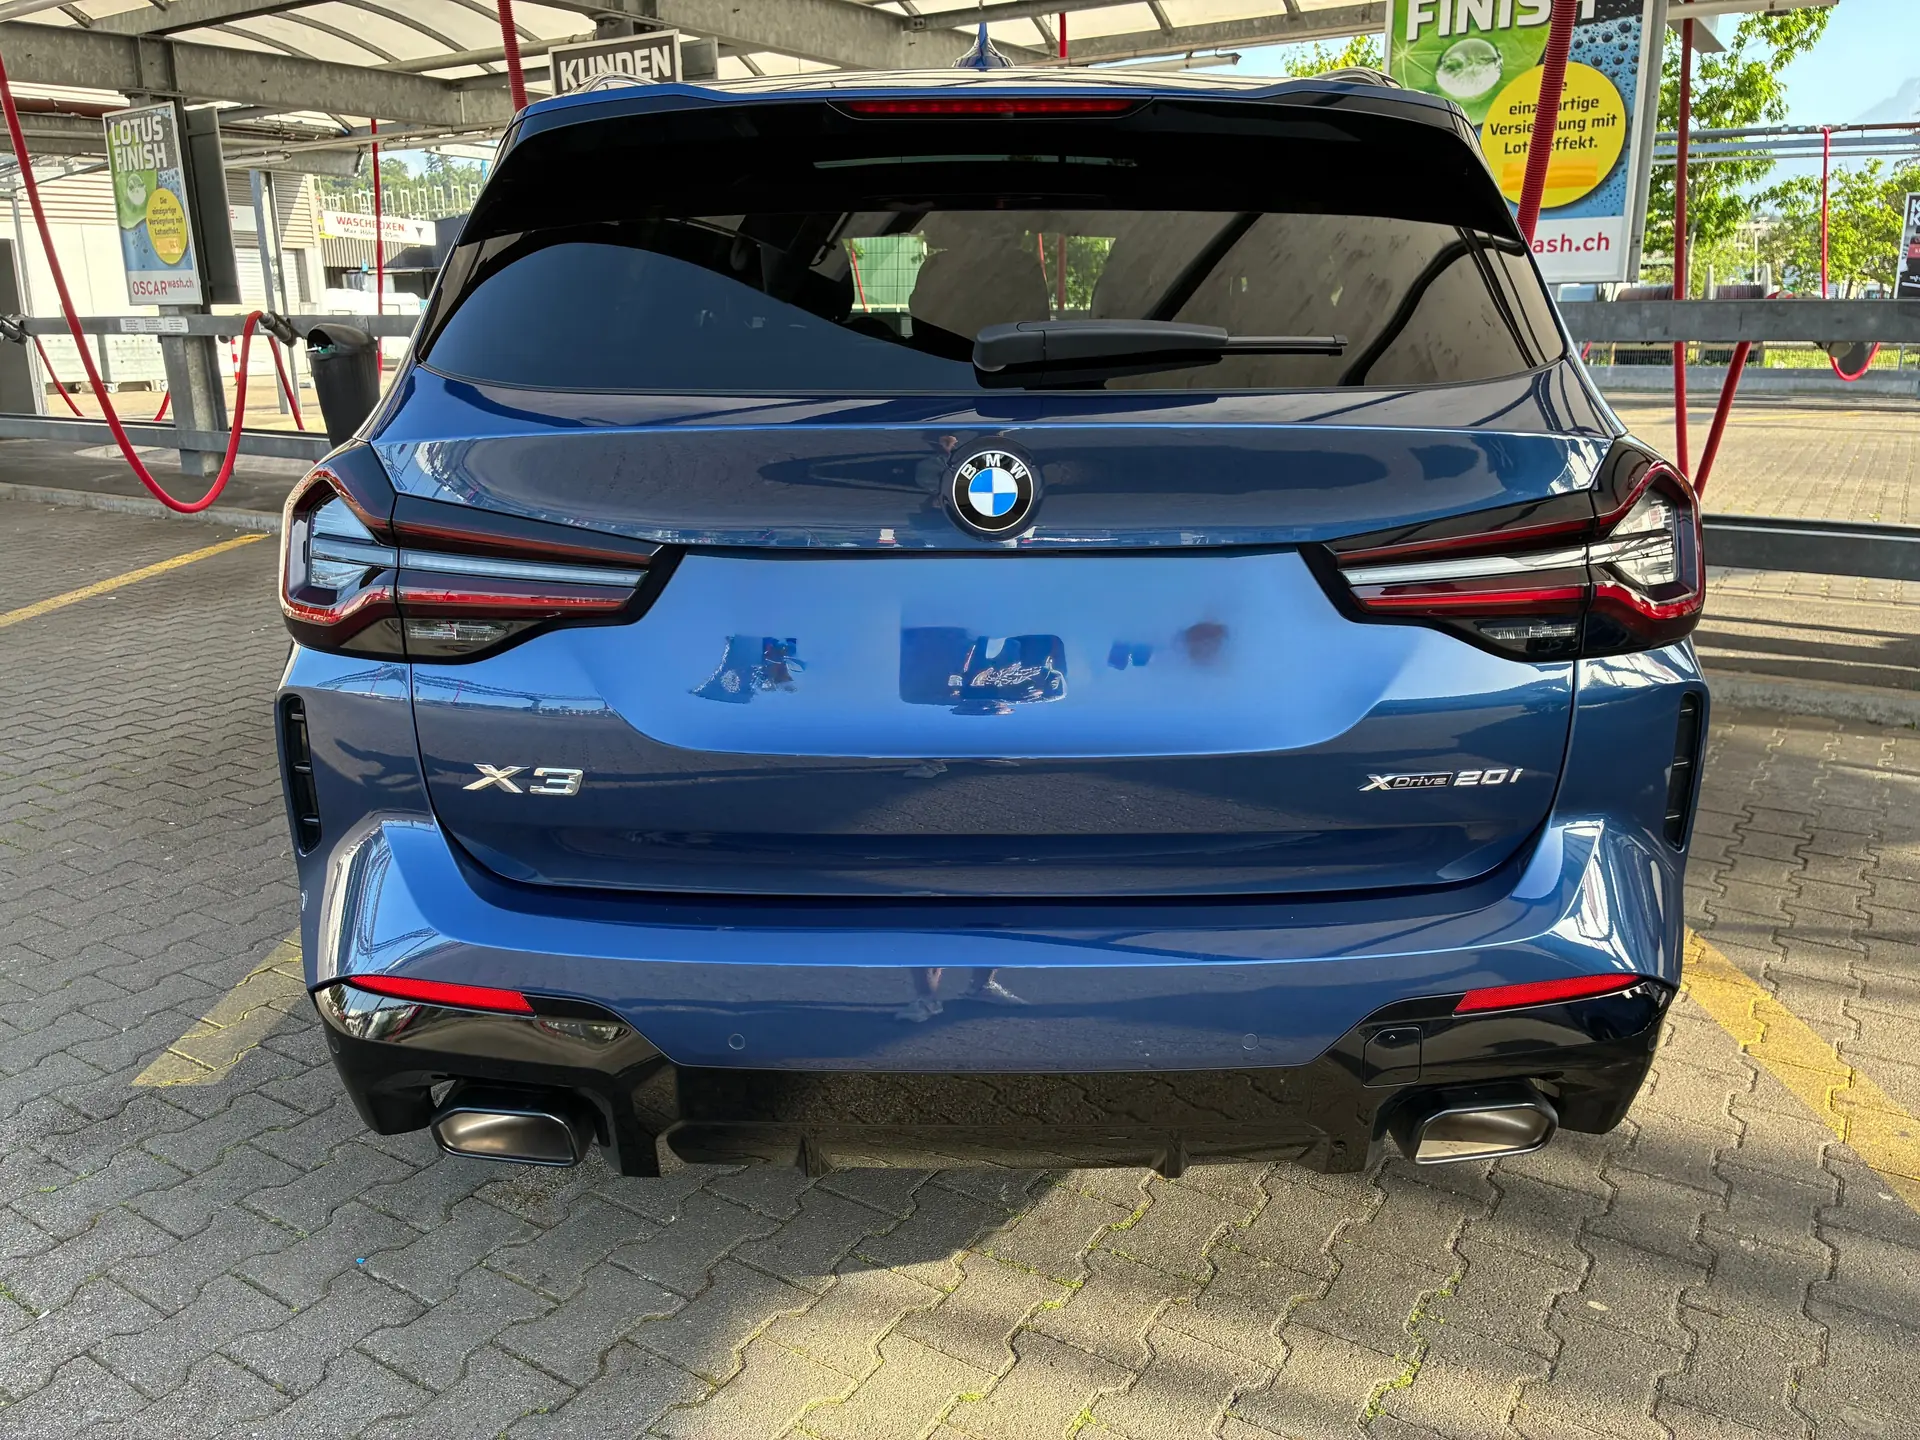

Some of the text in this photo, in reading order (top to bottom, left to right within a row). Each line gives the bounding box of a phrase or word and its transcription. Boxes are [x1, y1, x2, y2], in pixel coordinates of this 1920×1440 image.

[1406, 0, 1596, 41] FINIS
[559, 45, 672, 91] KUNDEN
[1509, 96, 1600, 115] einzrtige
[110, 115, 165, 146] LOTUS
[1490, 113, 1618, 136] Versielung mit
[114, 143, 168, 173] FINISH
[1504, 136, 1598, 155] Lotffekt.
[1532, 231, 1610, 253] ash.ch
[960, 453, 1026, 480] BMW
[462, 763, 584, 796] X3
